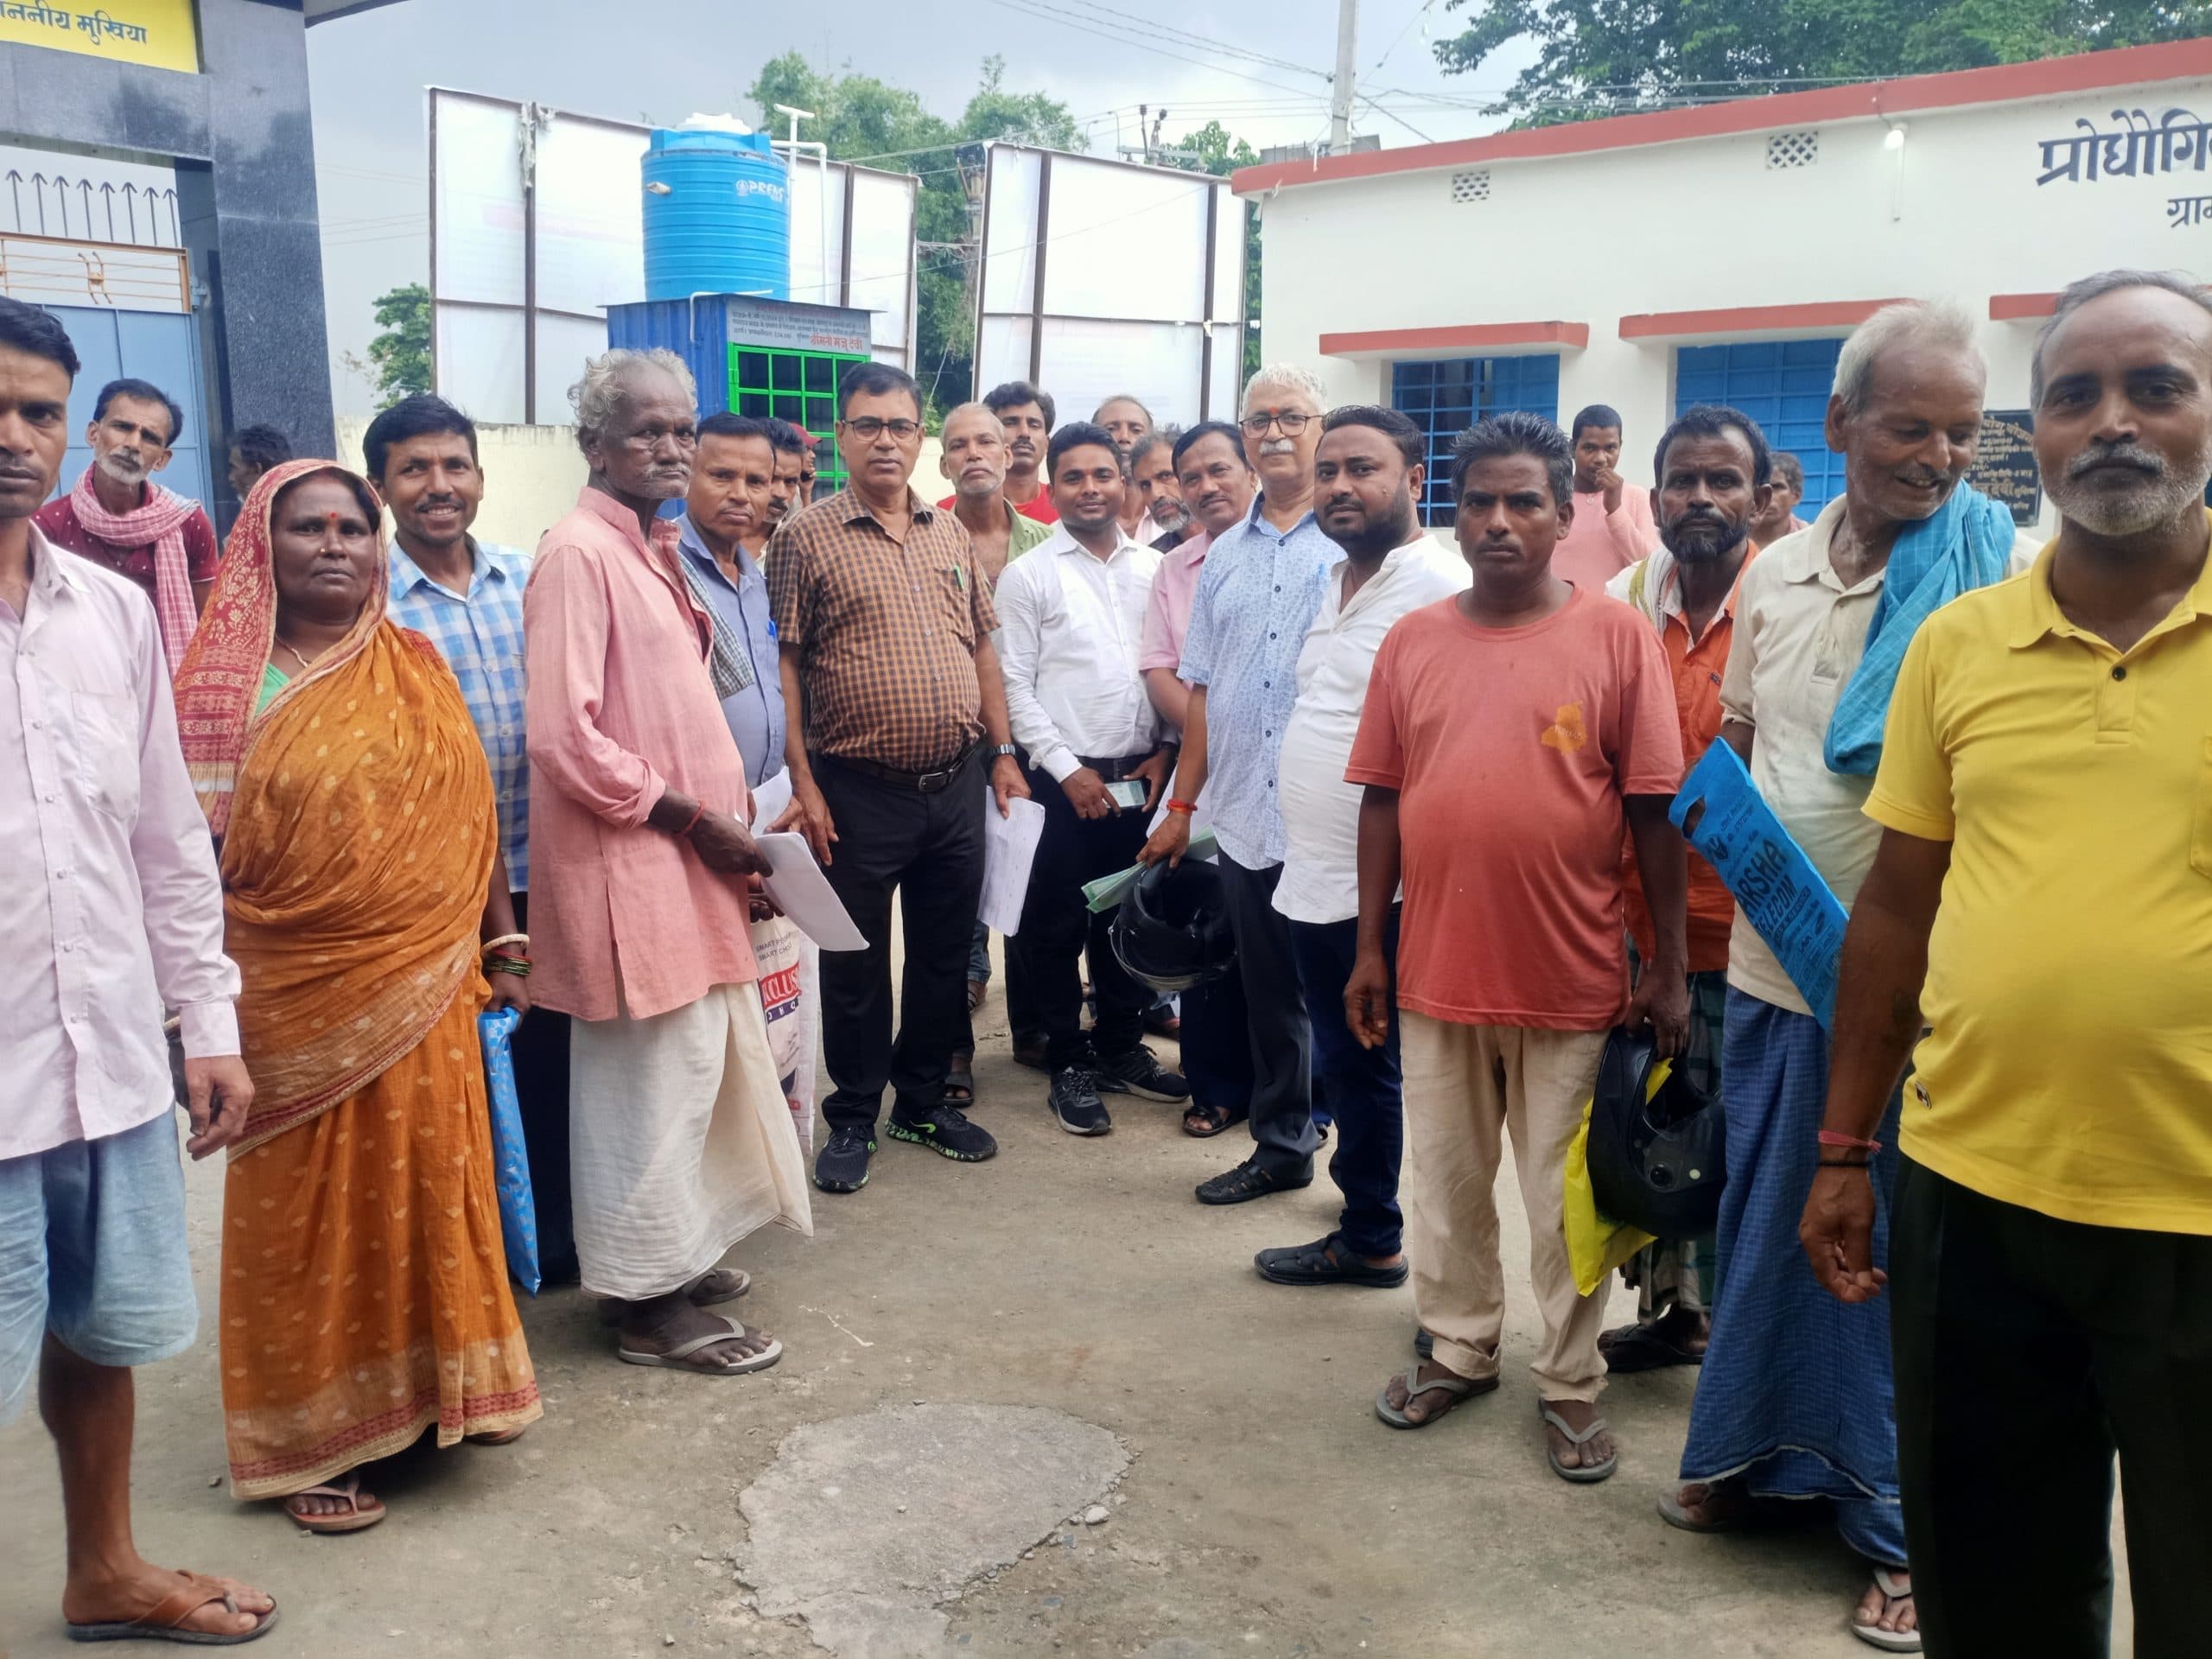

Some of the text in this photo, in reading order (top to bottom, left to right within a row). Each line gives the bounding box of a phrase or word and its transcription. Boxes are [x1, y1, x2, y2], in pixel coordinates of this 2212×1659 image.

[0, 0, 147, 45] ाननीय मुखिया
[1734, 838, 1787, 918] ARSHA
